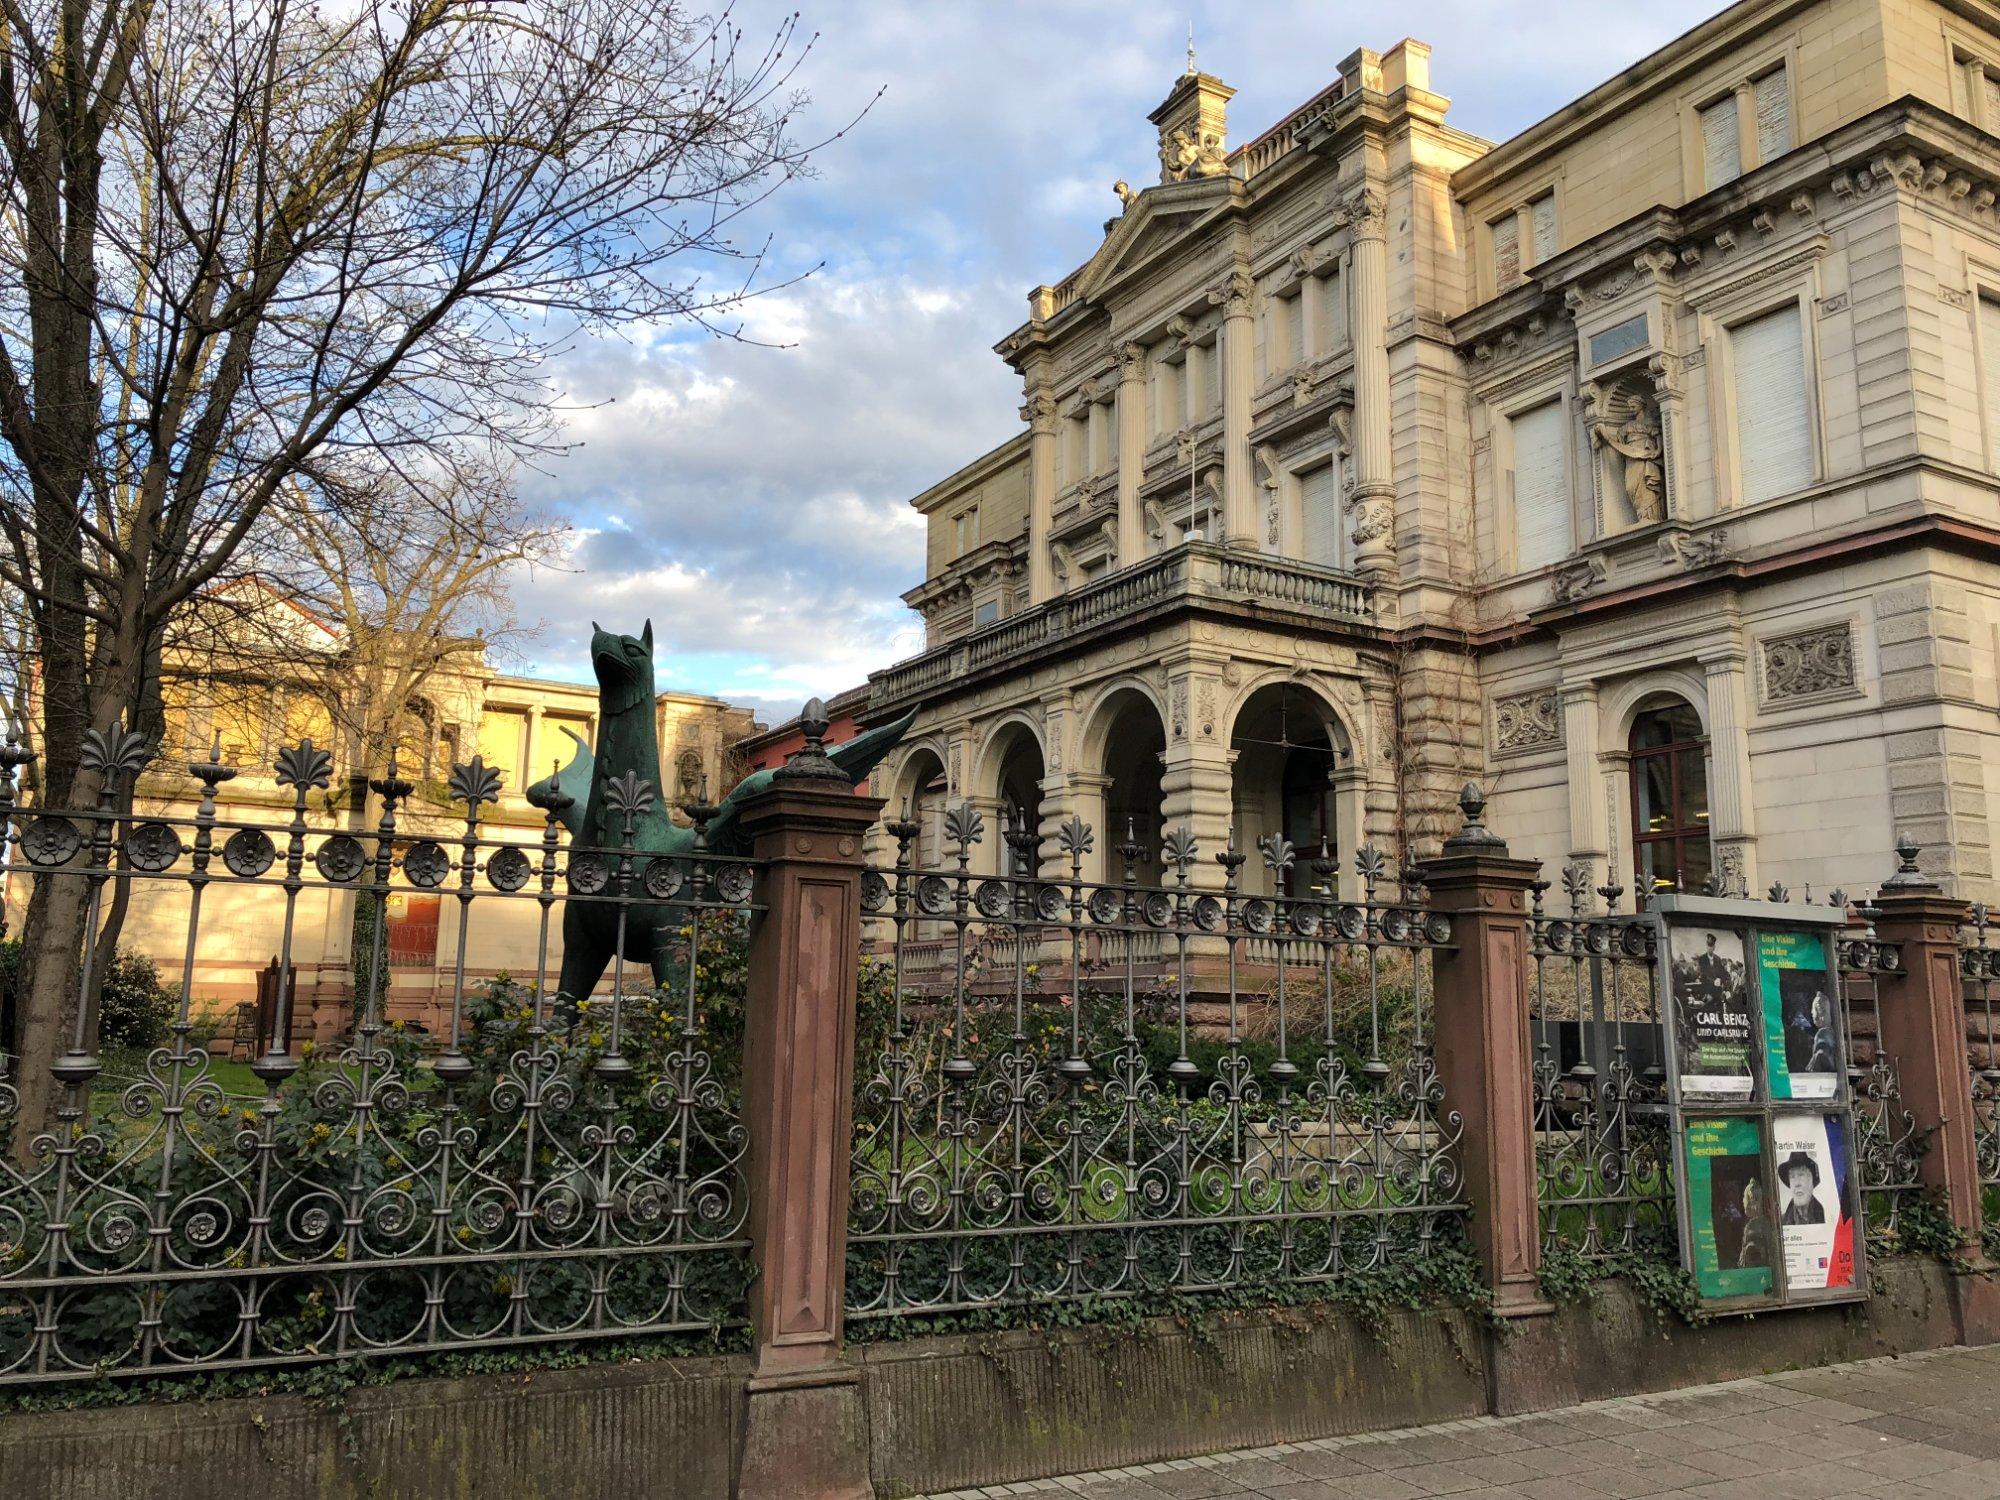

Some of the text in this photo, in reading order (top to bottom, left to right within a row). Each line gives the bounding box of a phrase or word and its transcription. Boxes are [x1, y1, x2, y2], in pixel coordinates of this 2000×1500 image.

[1761, 946, 1775, 956] und
[1696, 1012, 1748, 1026] CARL BENZ
[1696, 1028, 1712, 1037] UND
[1690, 1132, 1704, 1142] und
